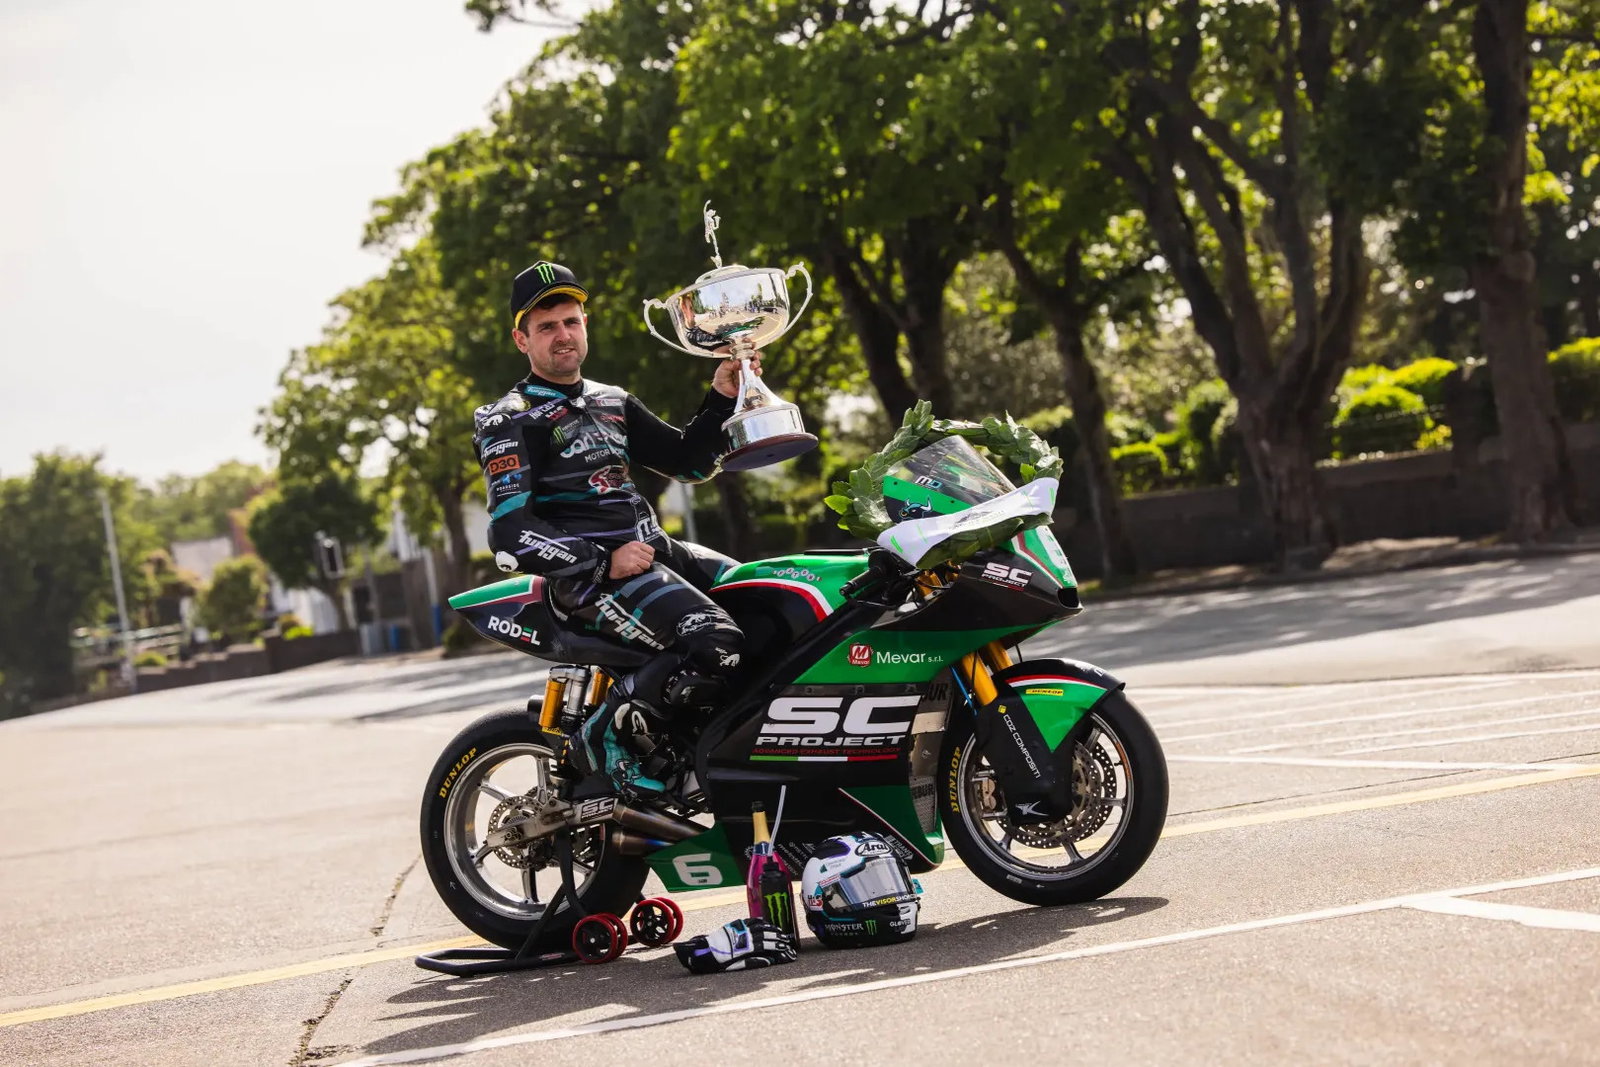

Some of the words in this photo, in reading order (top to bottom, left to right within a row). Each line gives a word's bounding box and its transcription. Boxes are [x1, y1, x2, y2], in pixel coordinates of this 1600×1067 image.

[981, 573, 1027, 588] PROJECT
[983, 562, 1034, 585] SC
[876, 651, 926, 664] Mevar
[760, 695, 922, 735] SC
[751, 747, 798, 755] ADVANCED
[755, 734, 907, 747] PROJECT
[1012, 732, 1041, 779] COMPOSITI
[439, 747, 477, 798] DUNLOP
[949, 746, 961, 814] DUNLOP
[861, 843, 889, 853] Arai
[672, 852, 723, 886] 6
